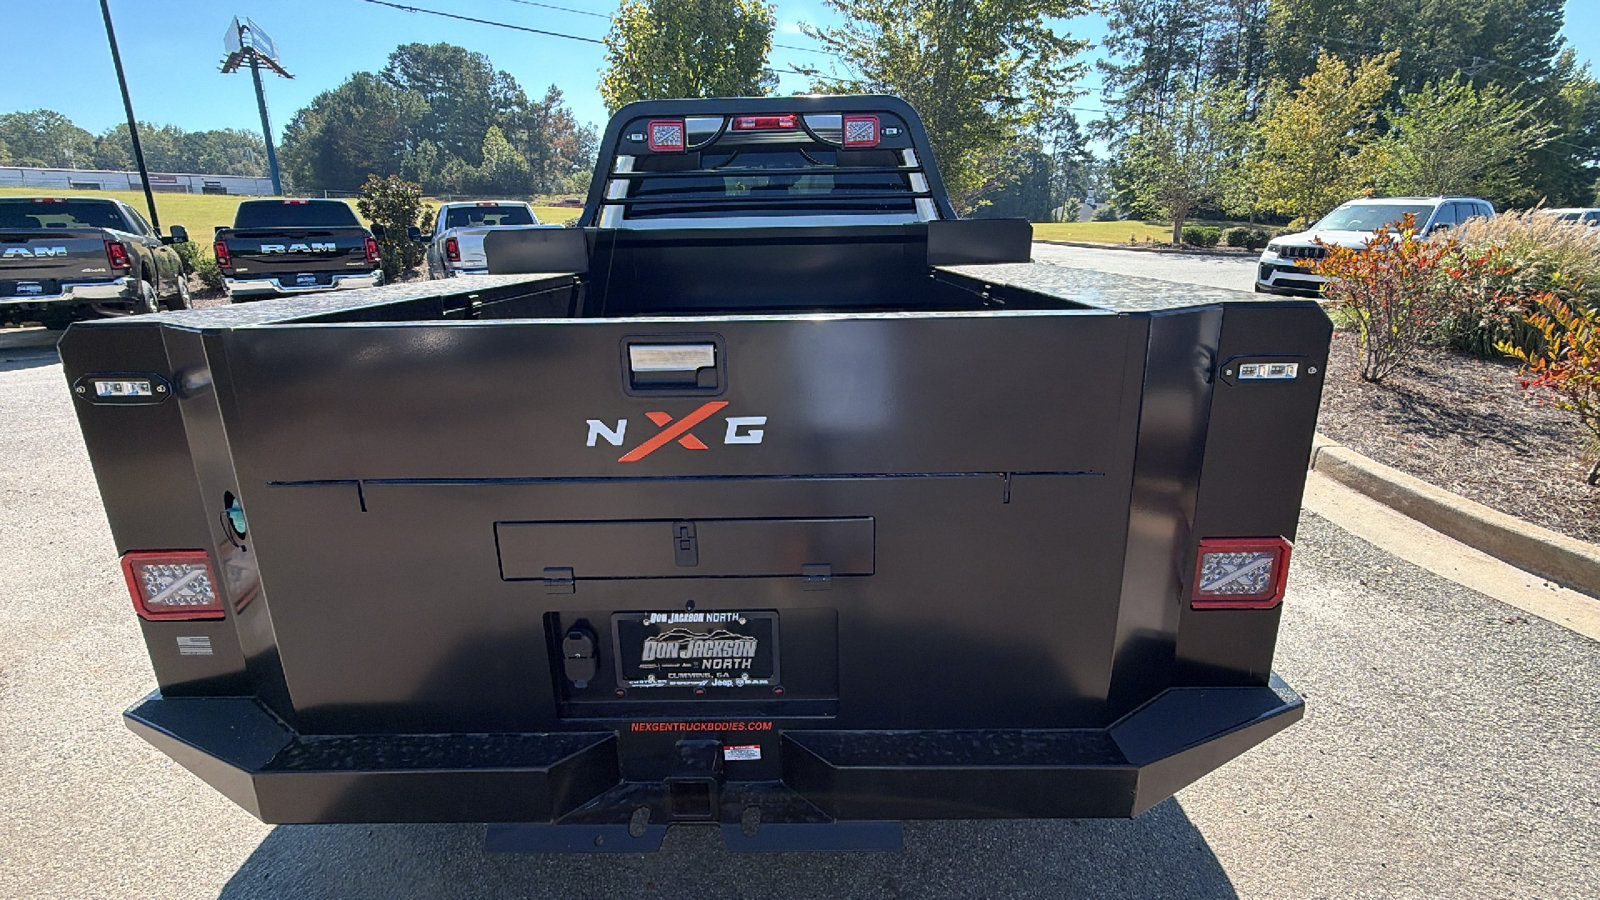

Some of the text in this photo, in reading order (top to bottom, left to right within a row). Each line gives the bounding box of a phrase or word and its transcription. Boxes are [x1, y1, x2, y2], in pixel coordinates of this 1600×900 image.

[2, 246, 68, 258] AM
[260, 242, 337, 254] RAM
[706, 612, 740, 623] NORTH
[642, 638, 759, 661] DON JACKSON
[701, 658, 752, 670] NORTH
[711, 678, 733, 687] Jeep
[631, 721, 773, 732] NEXGENTRUCKBODIES.COM
